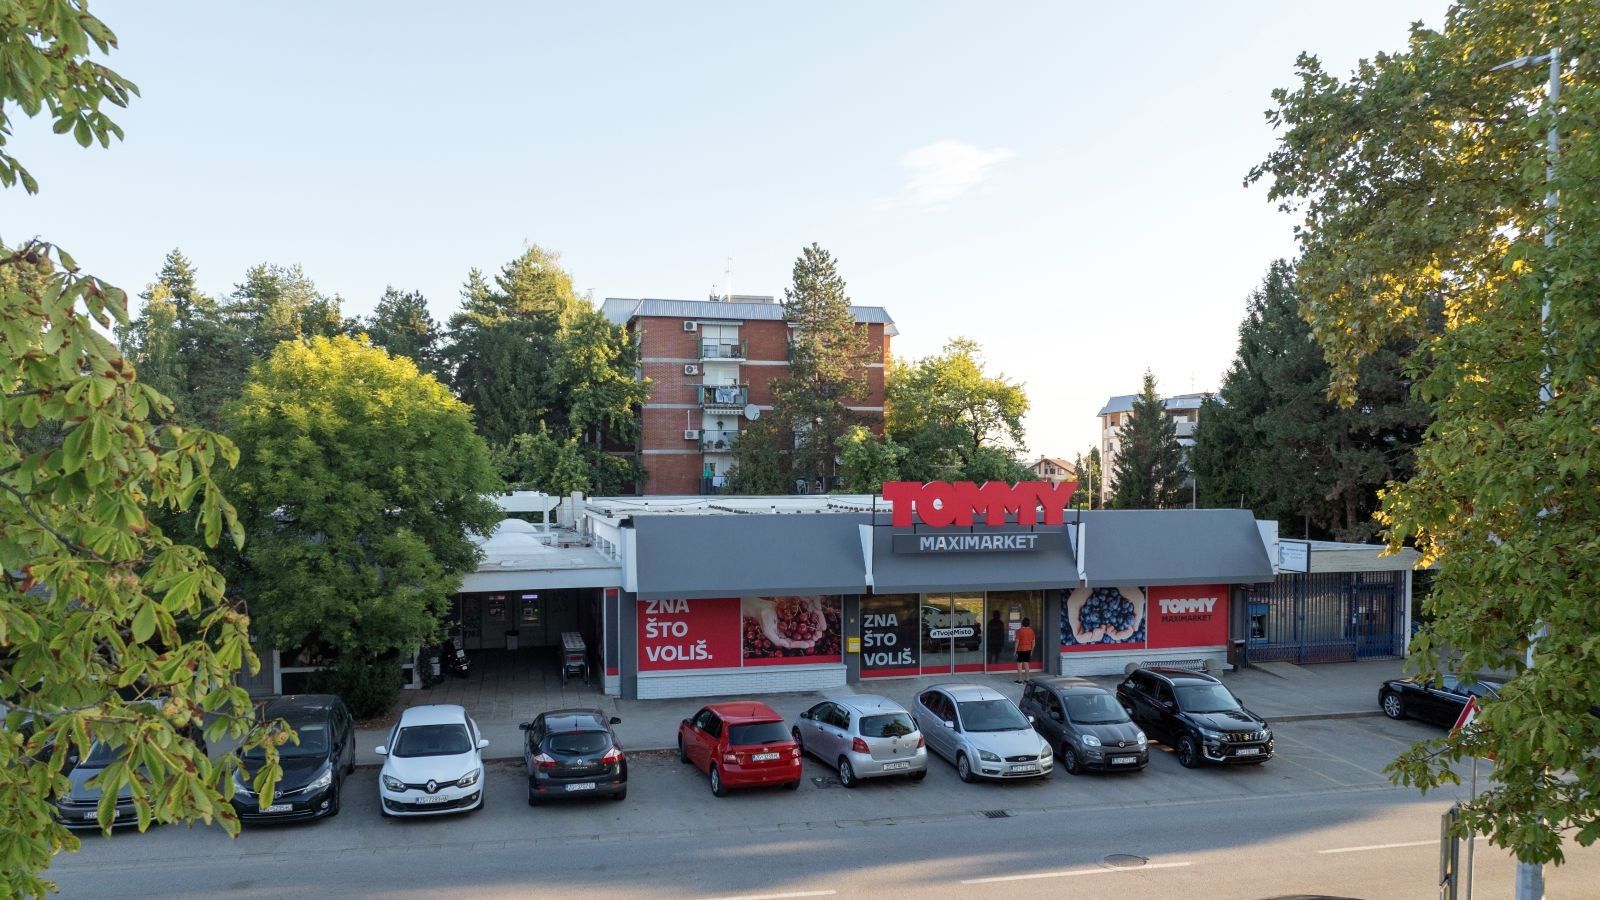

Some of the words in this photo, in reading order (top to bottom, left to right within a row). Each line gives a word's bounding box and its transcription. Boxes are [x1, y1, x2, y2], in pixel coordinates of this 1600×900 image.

[883, 480, 1076, 528] TOMMY
[920, 535, 1038, 551] MAXIMARKET
[1159, 597, 1218, 614] TOMMY
[645, 617, 689, 638] ŠTO
[863, 613, 898, 628] ZNA
[1161, 614, 1213, 623] MAXIMARKET
[863, 629, 897, 647] ŠTO
[645, 639, 713, 662] VOLIŠ.
[863, 647, 916, 666] VOLIŠ.
